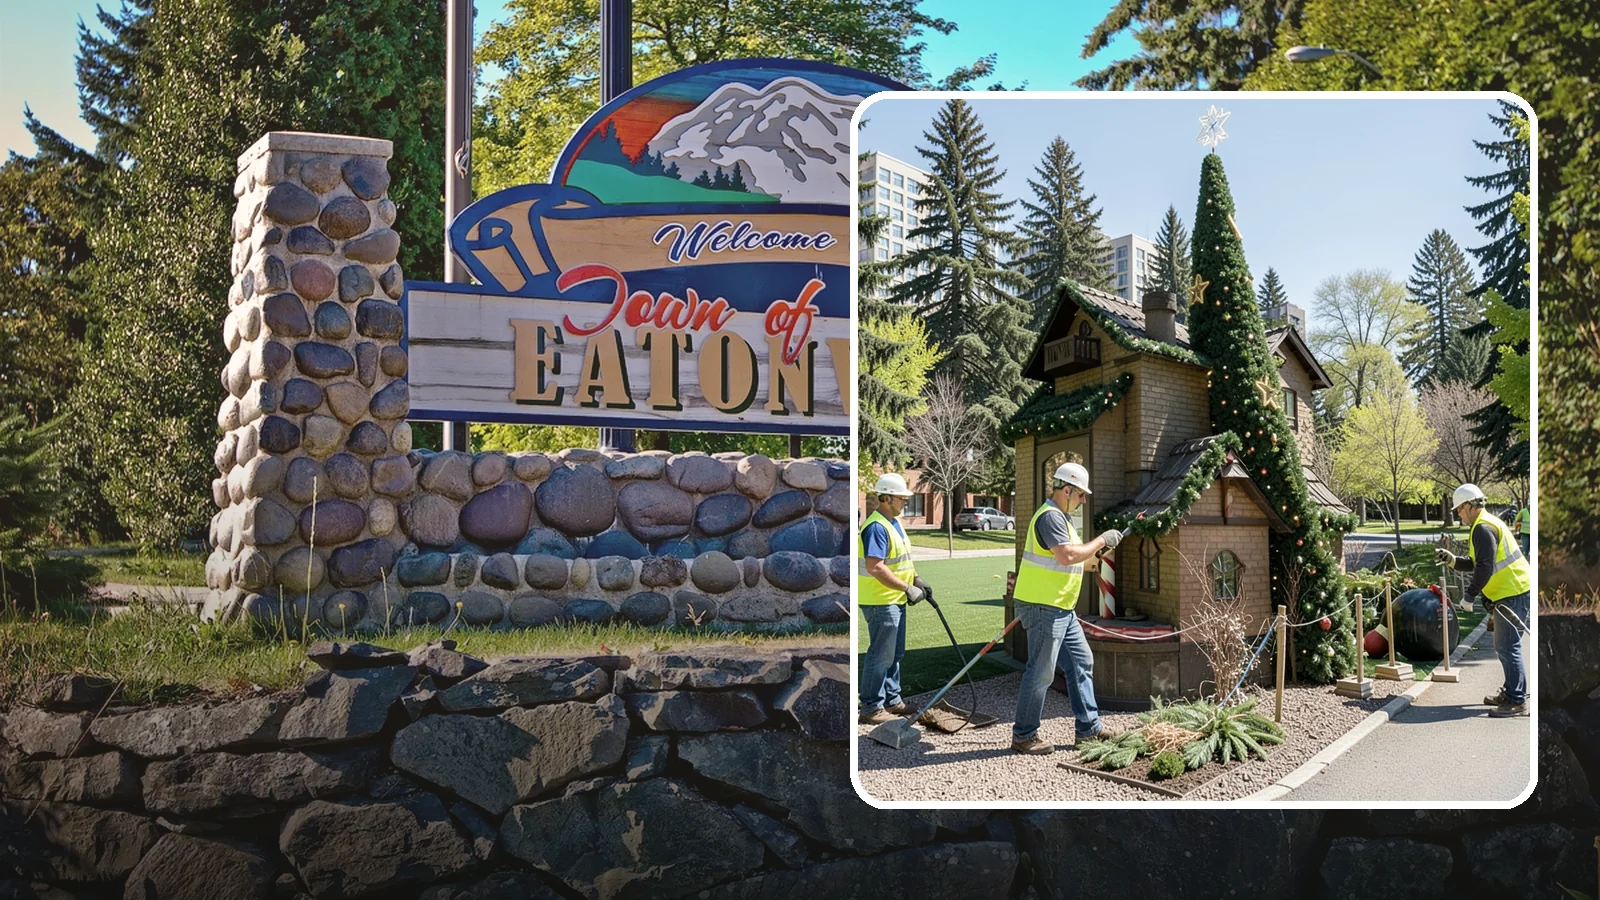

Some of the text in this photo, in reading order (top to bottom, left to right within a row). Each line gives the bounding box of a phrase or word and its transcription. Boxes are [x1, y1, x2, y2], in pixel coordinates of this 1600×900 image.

[653, 220, 838, 263] Welcome
[557, 264, 826, 365] Town of
